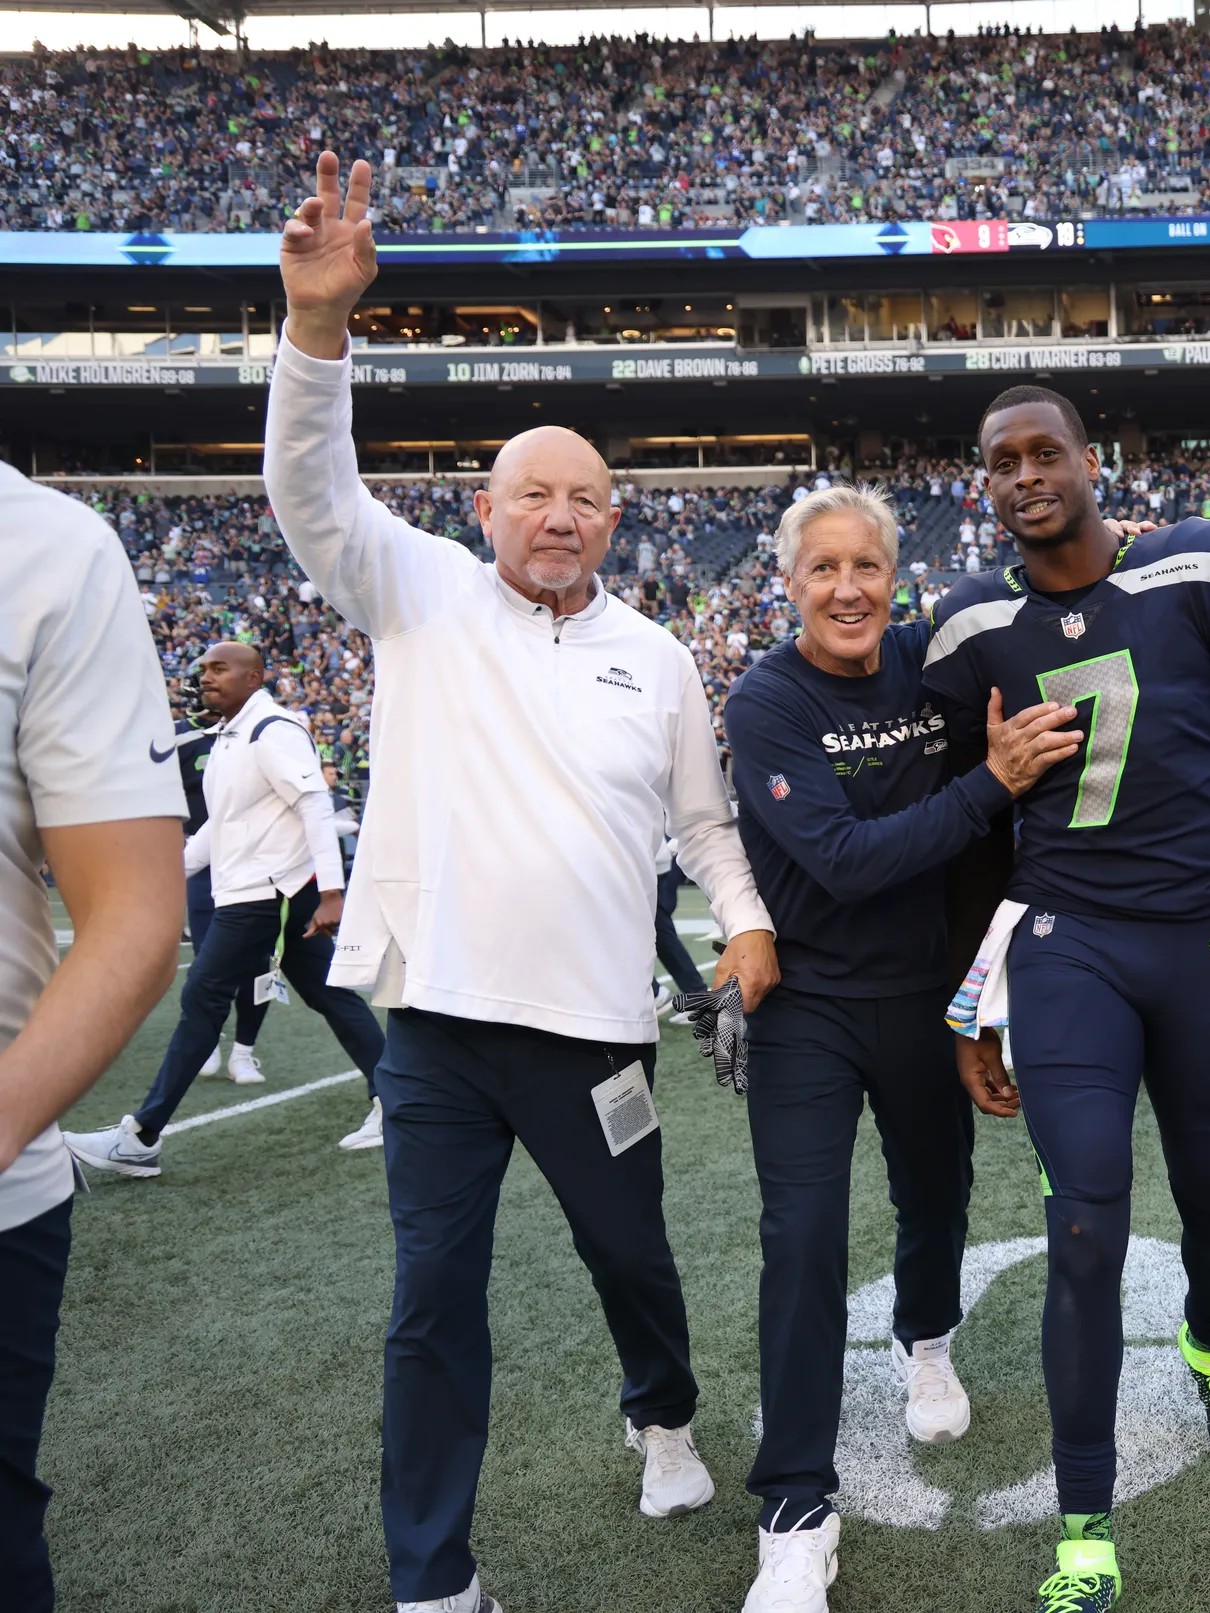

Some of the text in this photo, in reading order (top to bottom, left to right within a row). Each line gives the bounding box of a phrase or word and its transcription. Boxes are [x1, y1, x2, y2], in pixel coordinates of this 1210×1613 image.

[977, 222, 991, 248] 9
[1055, 222, 1074, 247] 19
[1168, 222, 1208, 238] BALL ON
[612, 360, 636, 379] 22
[636, 359, 672, 378] DAVE
[673, 358, 726, 377] BROWN
[811, 356, 845, 374] PETE
[847, 355, 894, 373] GROSS
[965, 351, 990, 370] 28
[991, 351, 1027, 369] CURT
[1029, 349, 1088, 368] WARNER
[36, 364, 77, 384] MIKE
[80, 364, 161, 384] HOLMGREN
[238, 366, 265, 384] 80
[447, 363, 470, 382] 10
[473, 363, 499, 382] JIM
[501, 362, 540, 381] ZORN
[1140, 563, 1200, 582] SEAHAWKS
[596, 676, 643, 693] SEAHAWKS
[821, 713, 946, 753] SEAHAWKS
[1035, 648, 1140, 828] 7
